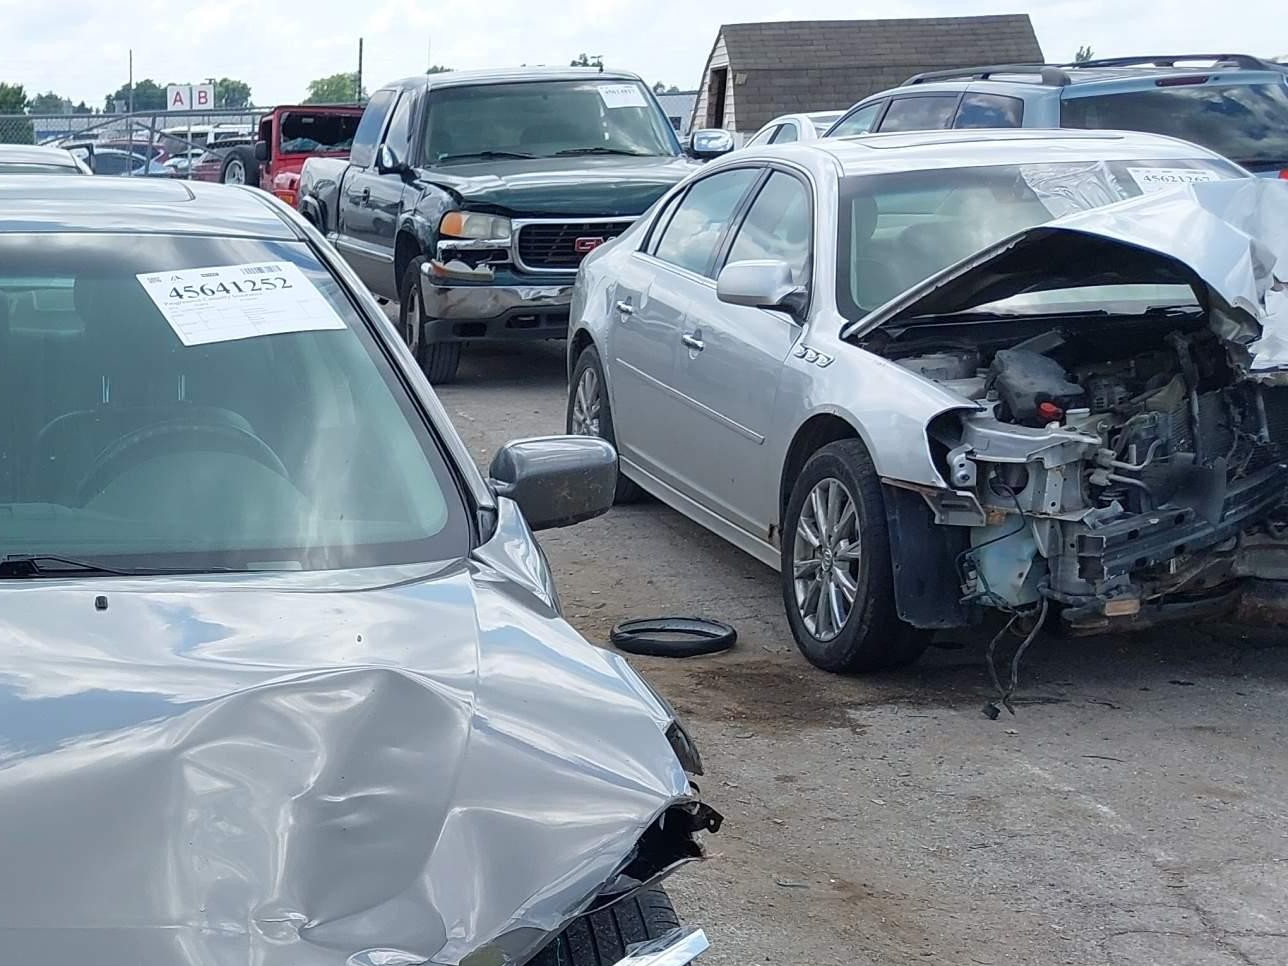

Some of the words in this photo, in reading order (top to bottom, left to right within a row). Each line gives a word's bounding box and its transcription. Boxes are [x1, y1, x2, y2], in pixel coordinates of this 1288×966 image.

[172, 91, 184, 106] A
[198, 90, 208, 105] B
[169, 277, 293, 300] 45641252
